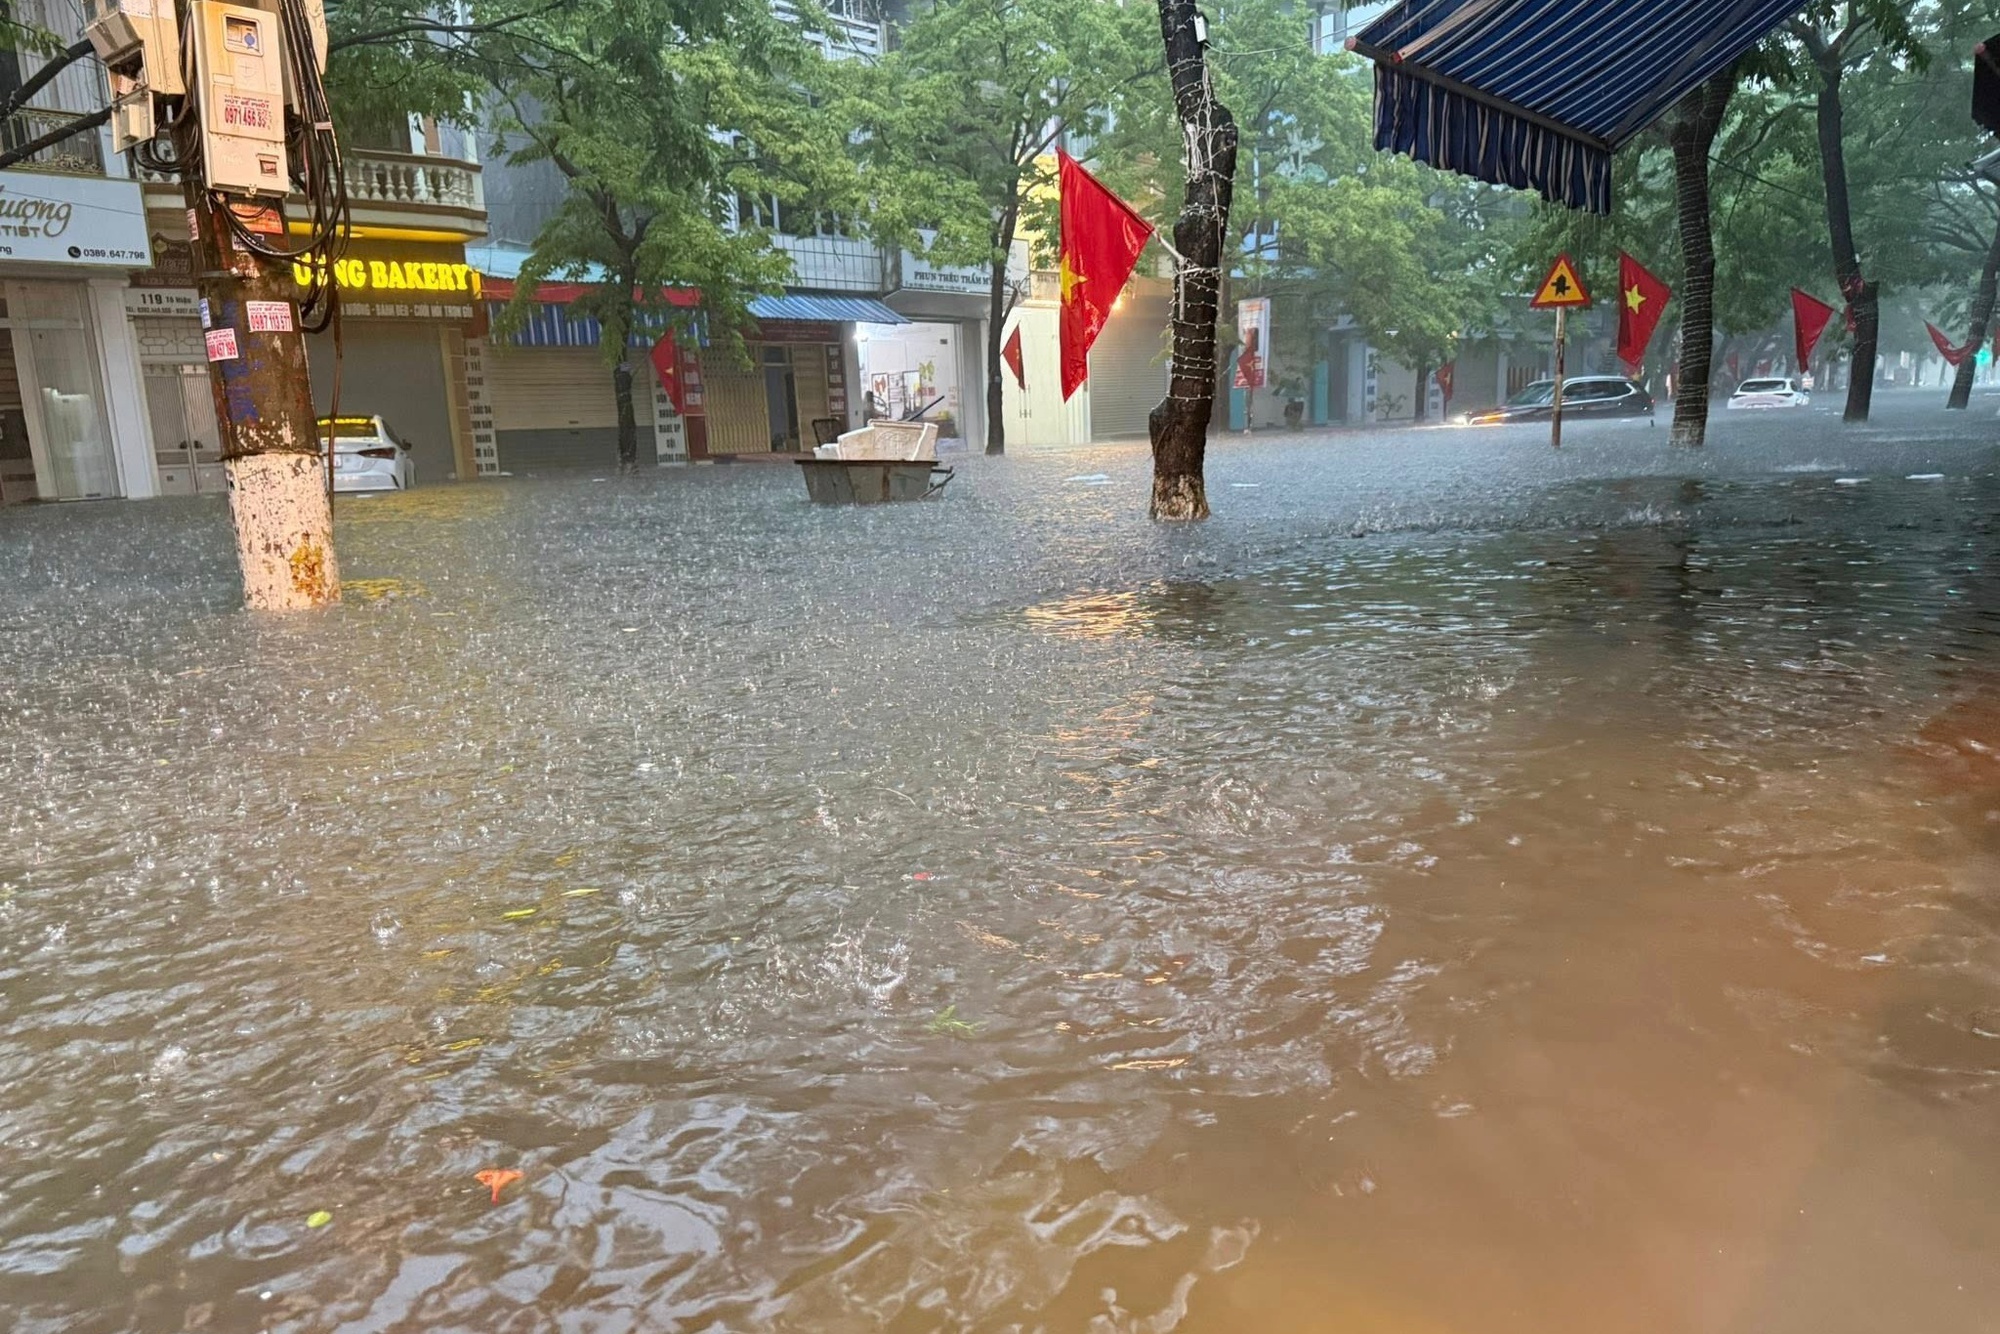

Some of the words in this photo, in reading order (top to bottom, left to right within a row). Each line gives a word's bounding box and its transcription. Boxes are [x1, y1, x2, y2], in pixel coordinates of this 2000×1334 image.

[0, 225, 41, 238] TIST
[83, 248, 146, 259] 0389.647.798
[369, 260, 469, 291] BAKERY
[914, 271, 937, 281] PHUN
[938, 272, 959, 283] THÊU
[141, 293, 163, 304] 119
